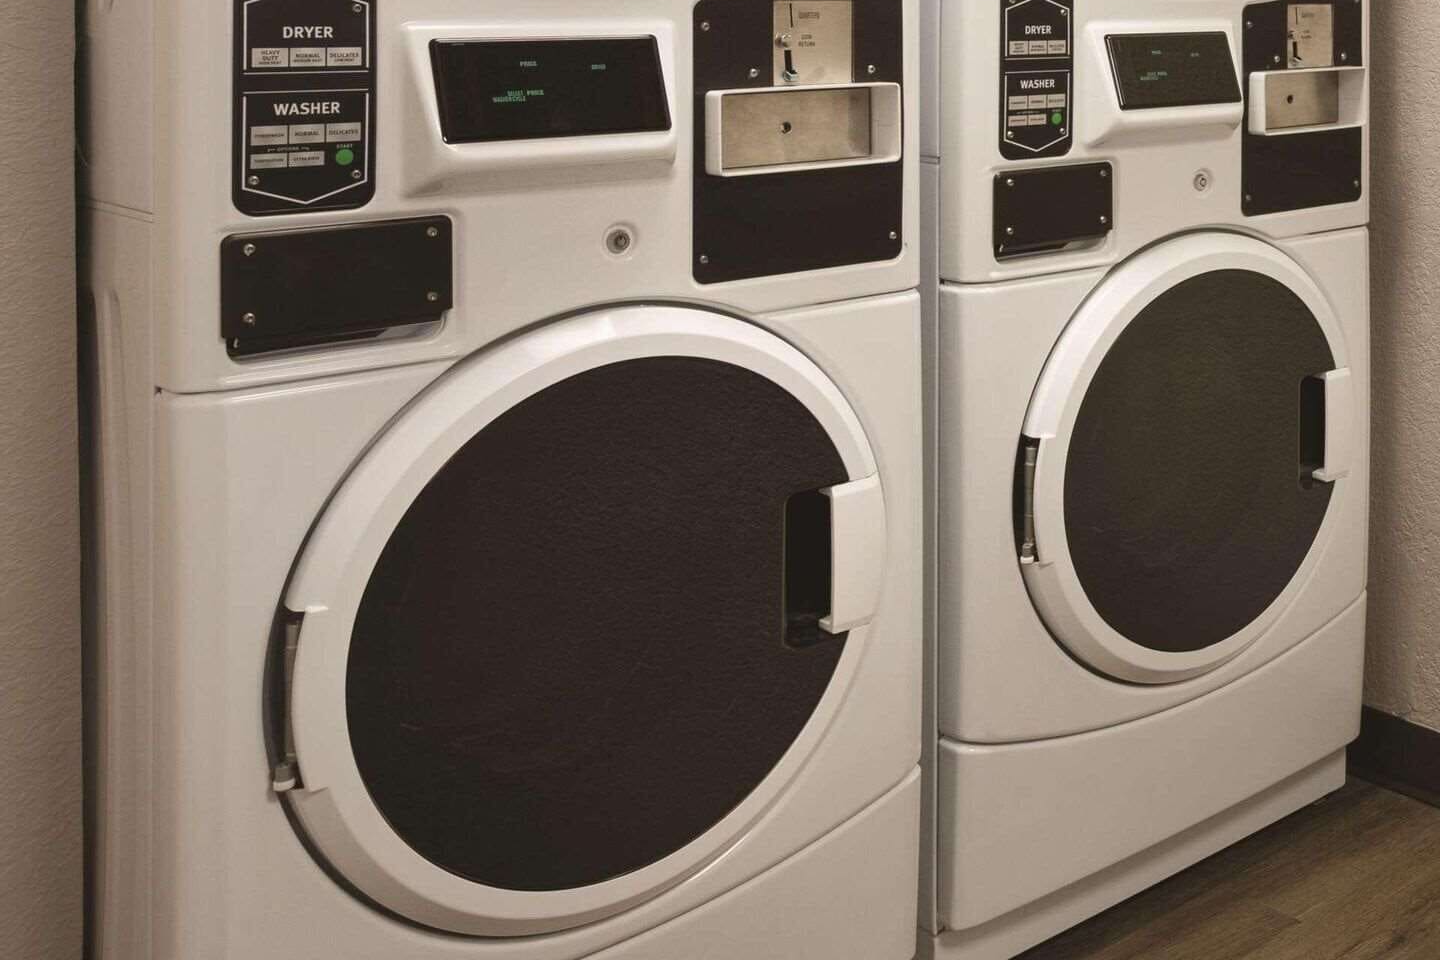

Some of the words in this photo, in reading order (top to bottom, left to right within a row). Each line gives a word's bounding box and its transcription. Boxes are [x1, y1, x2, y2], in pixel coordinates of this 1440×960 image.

[282, 26, 334, 39] DRYER
[1024, 25, 1052, 35] DRYER
[1020, 79, 1056, 89] WASHER
[273, 101, 341, 116] WASHER
